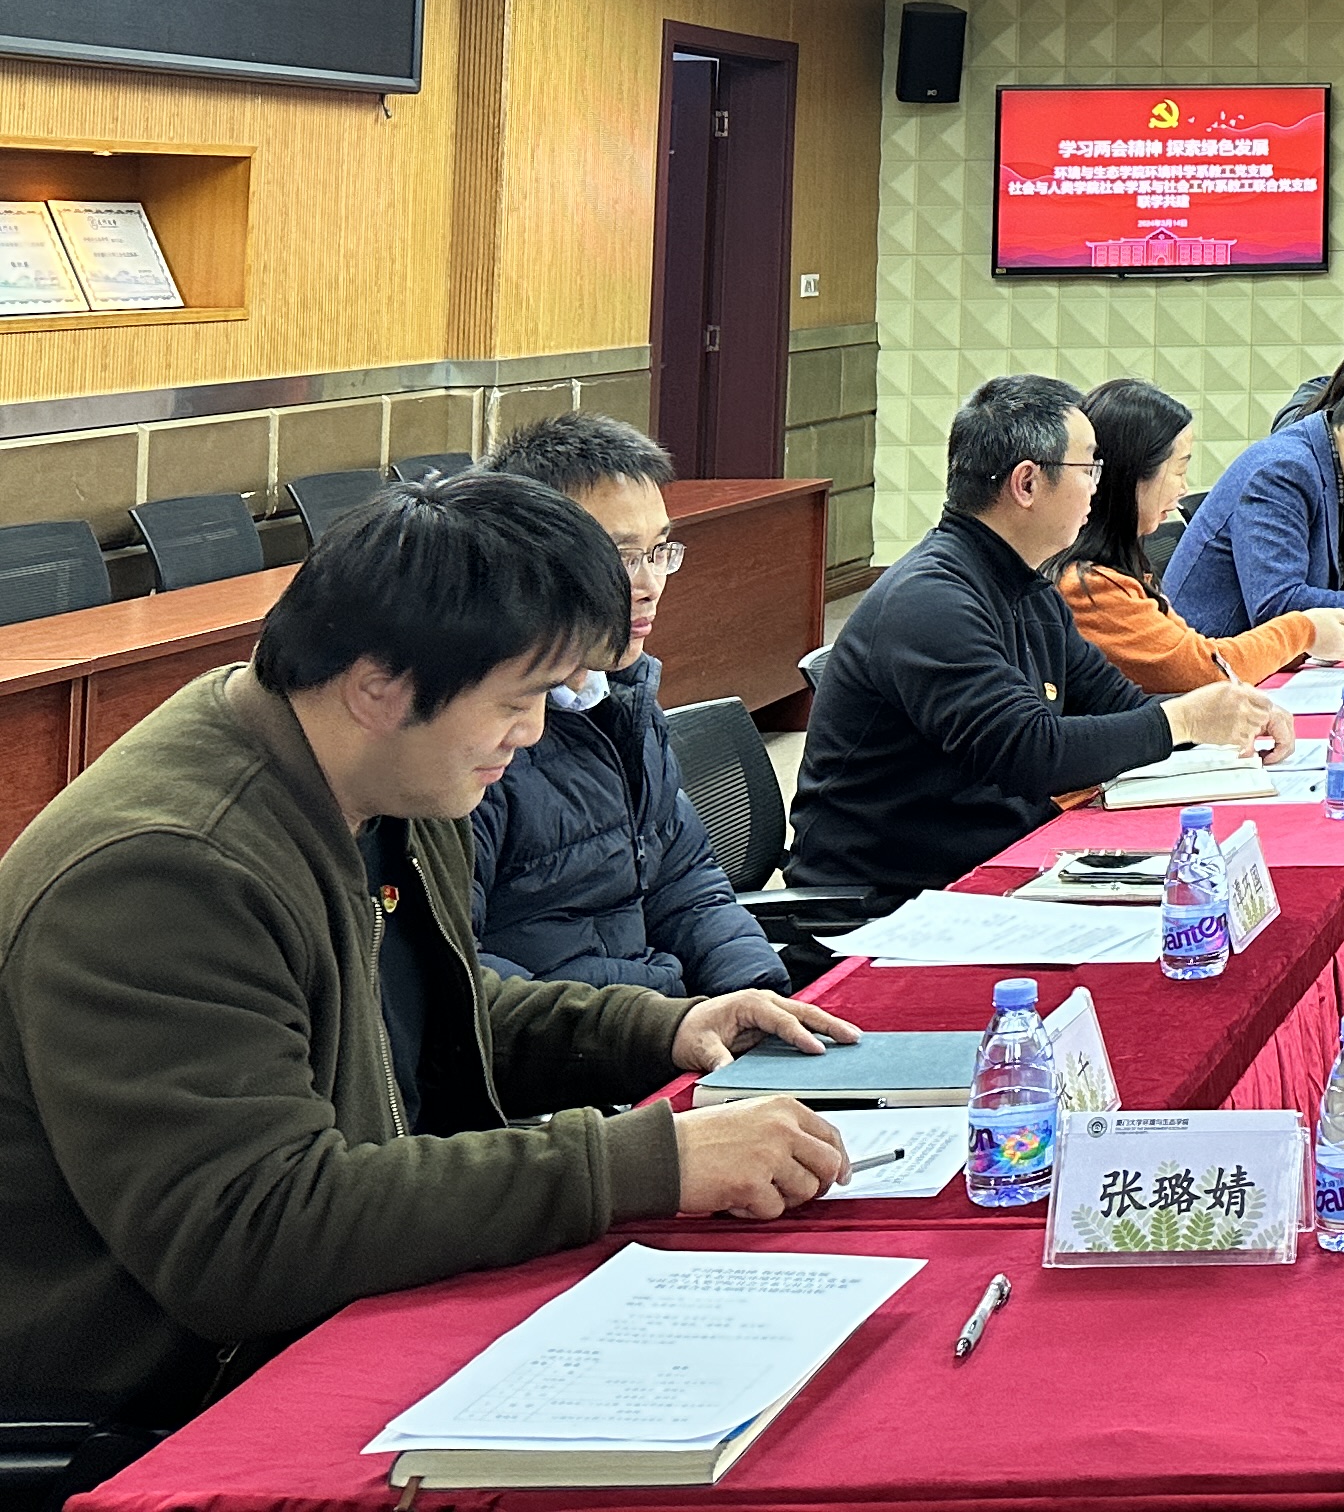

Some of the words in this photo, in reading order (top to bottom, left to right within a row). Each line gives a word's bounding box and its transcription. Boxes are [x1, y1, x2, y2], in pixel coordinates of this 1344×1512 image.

[1058, 138, 1162, 158] 学习两会精神
[1166, 138, 1269, 157] 探索绿色发展
[1099, 1164, 1256, 1219] 张璐婧
